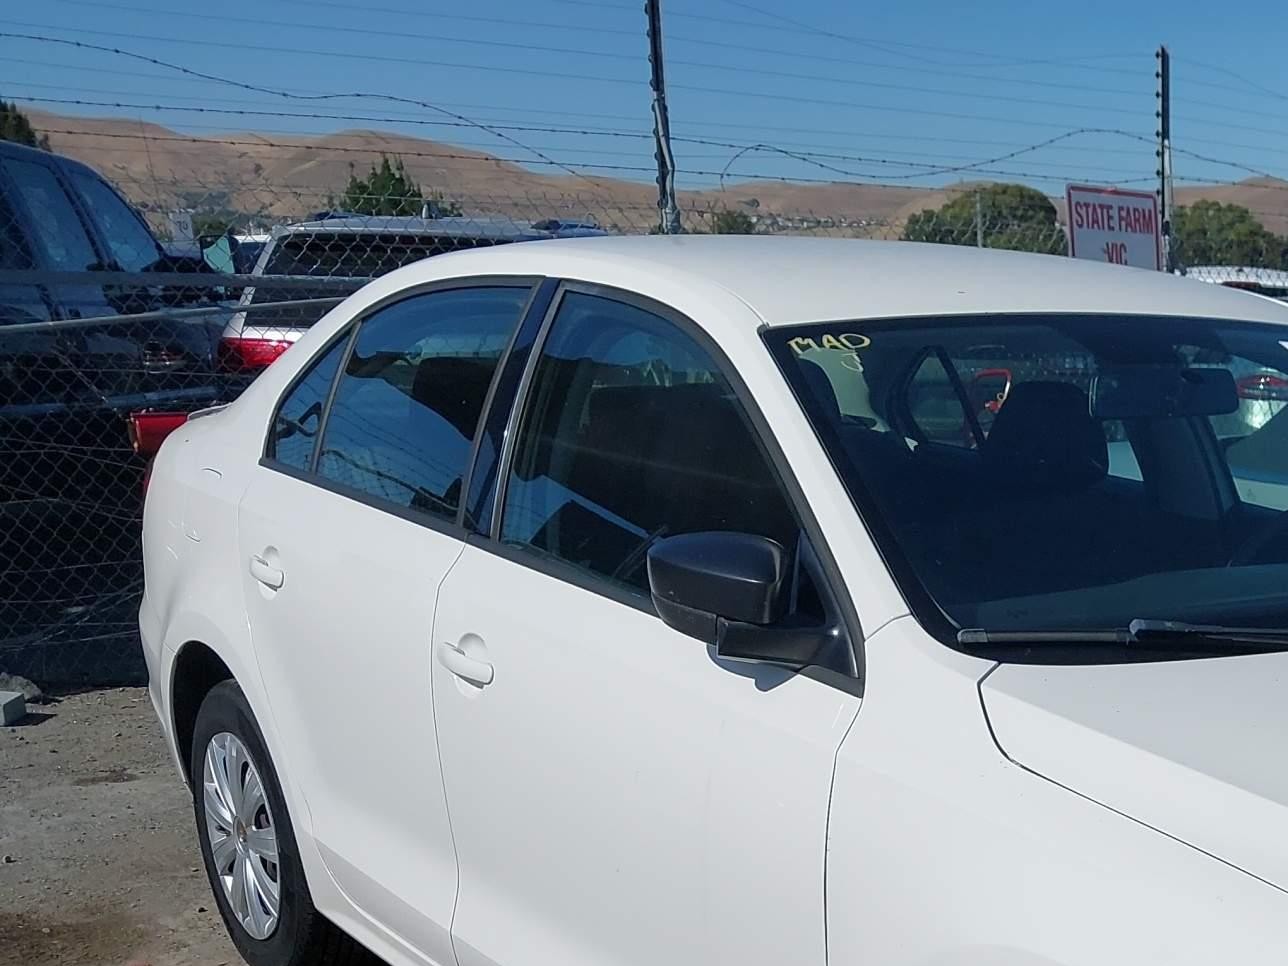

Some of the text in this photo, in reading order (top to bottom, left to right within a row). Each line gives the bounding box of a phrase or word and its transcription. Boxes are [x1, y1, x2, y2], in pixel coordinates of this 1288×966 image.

[1075, 202, 1154, 234] STATE FARM
[1105, 241, 1128, 266] VIC
